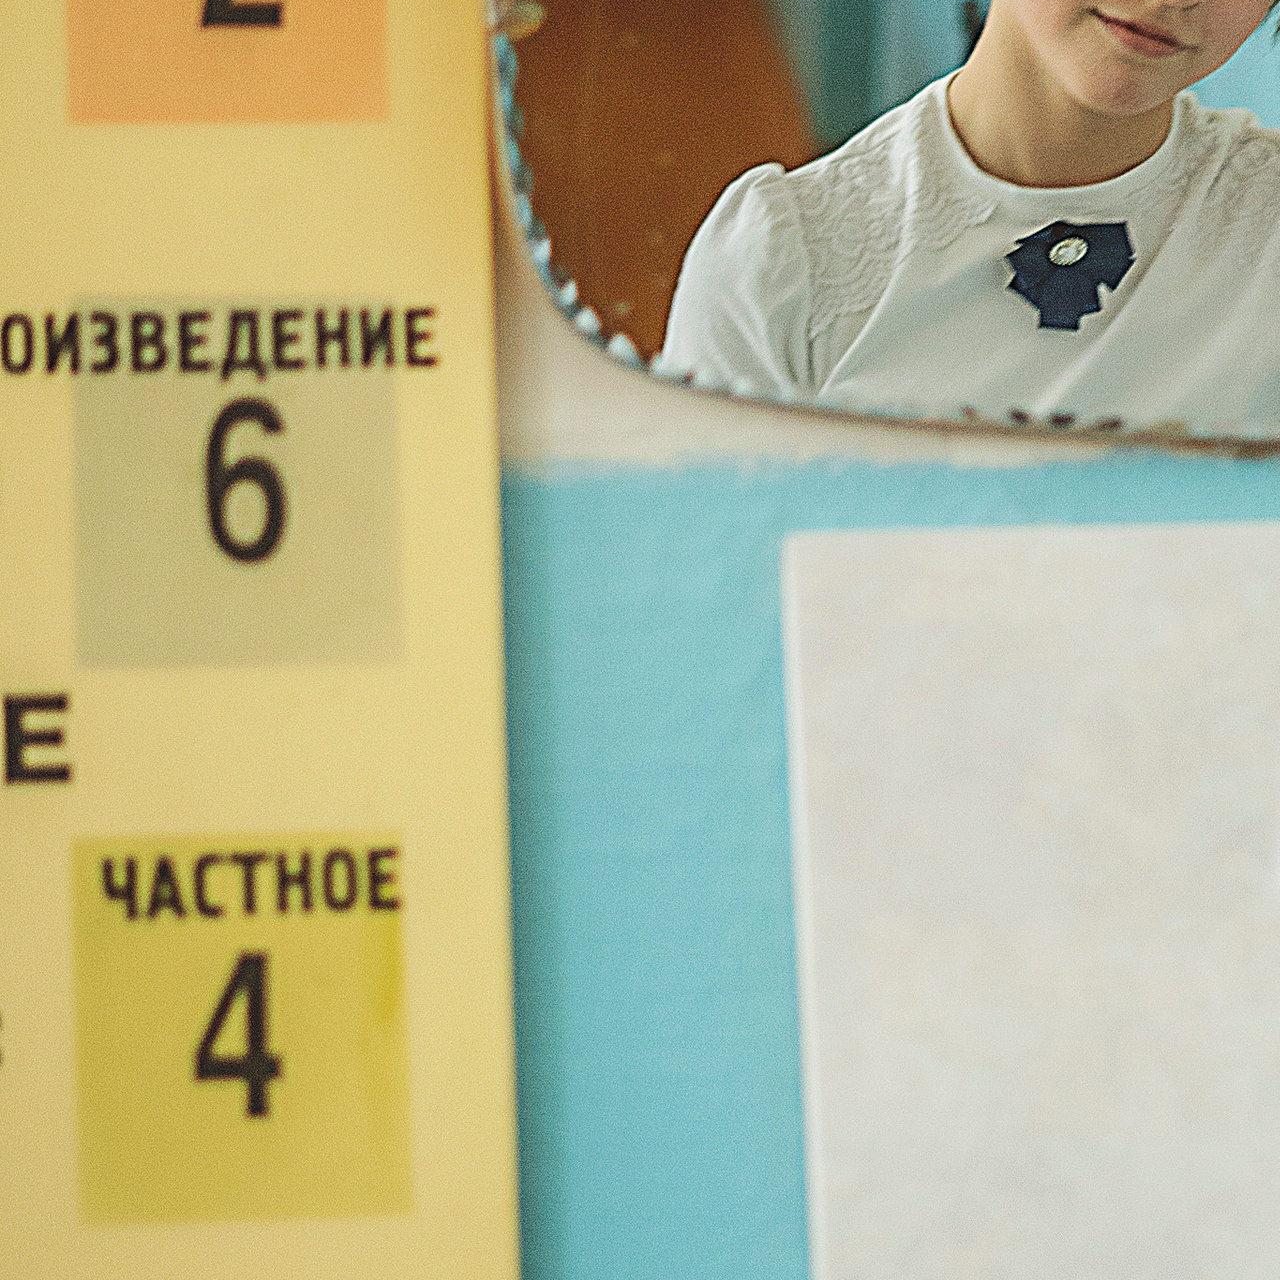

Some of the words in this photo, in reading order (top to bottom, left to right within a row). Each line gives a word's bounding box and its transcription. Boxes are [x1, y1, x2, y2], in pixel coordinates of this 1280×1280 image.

[0, 307, 440, 382] ОИЗВЕДЕНИЕ
[203, 396, 288, 564] 6
[100, 847, 402, 922] ЧАСТНОЕ
[192, 951, 284, 1119] 4
